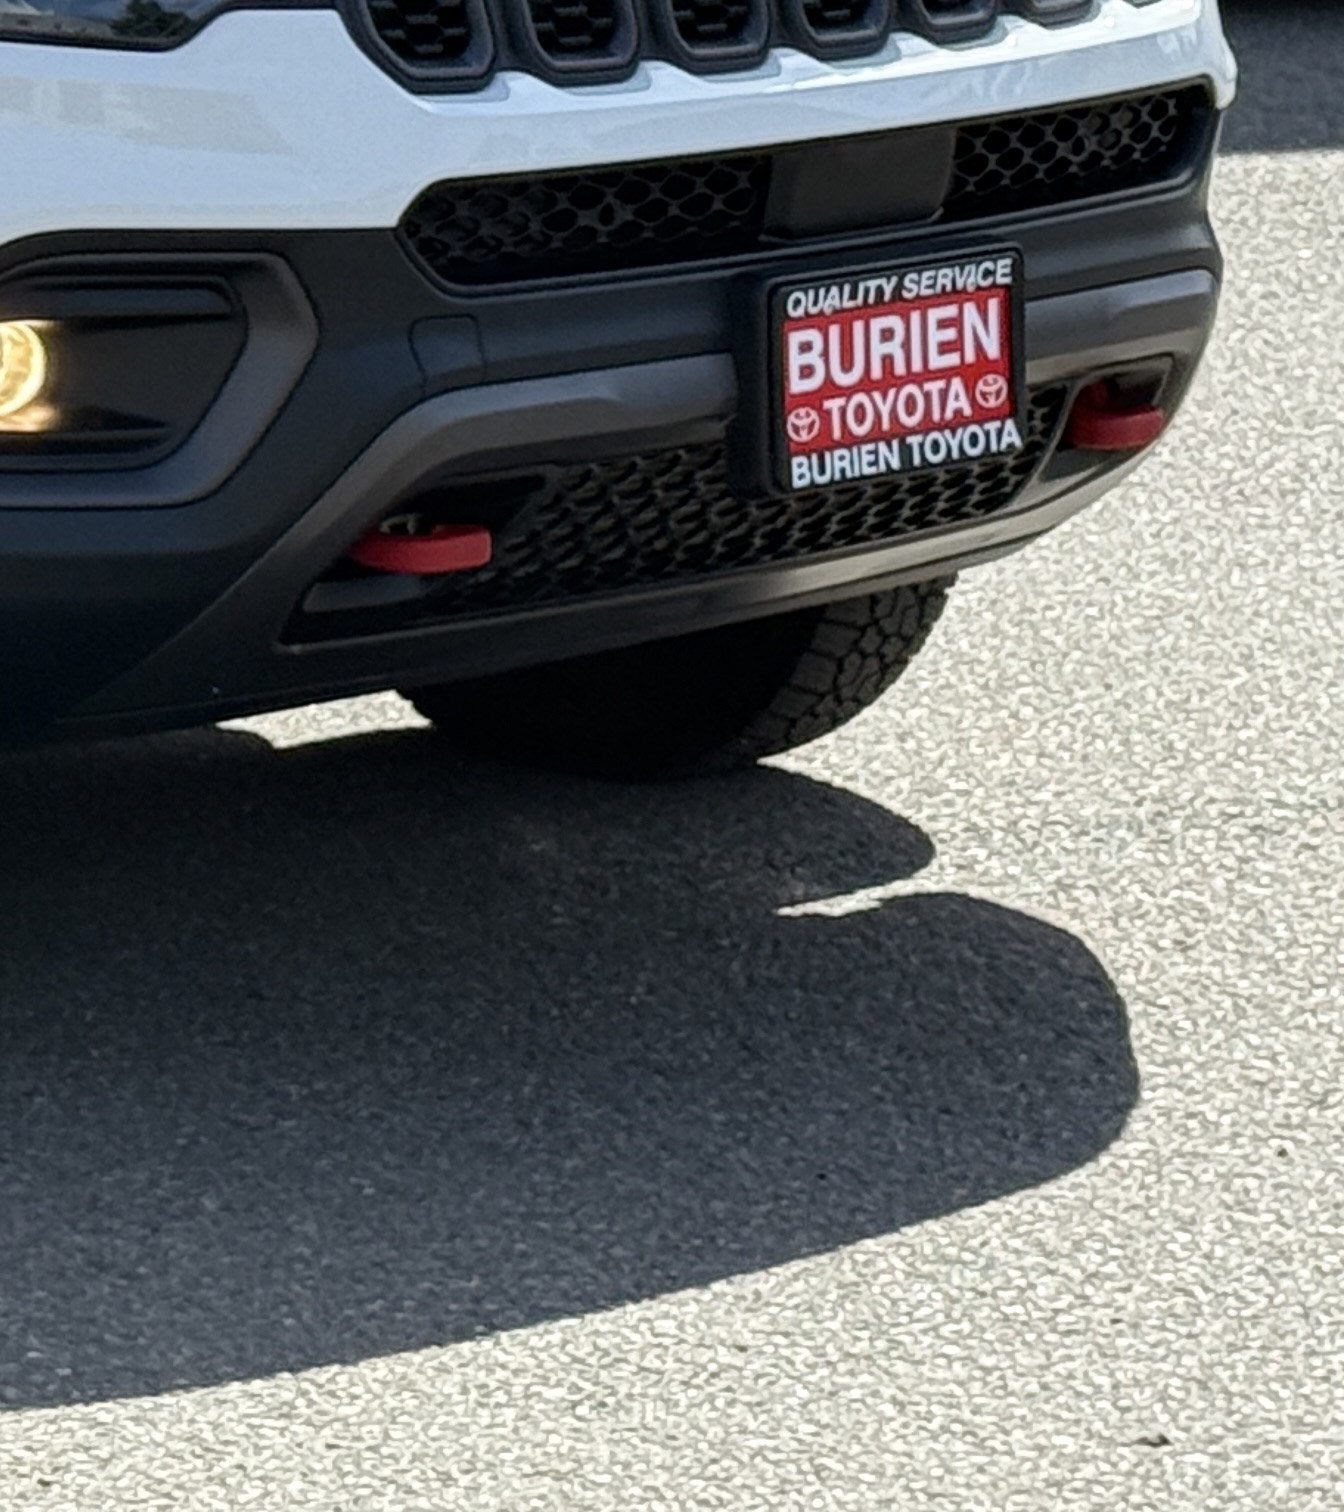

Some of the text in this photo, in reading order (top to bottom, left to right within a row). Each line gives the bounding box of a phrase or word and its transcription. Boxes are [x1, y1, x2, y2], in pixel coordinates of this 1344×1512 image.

[787, 258, 1014, 318] QUALITY SERVICE
[786, 297, 1002, 395] BURIEN
[822, 377, 972, 441] TOYOTA
[790, 418, 1024, 489] BURIEN TOYOTA
